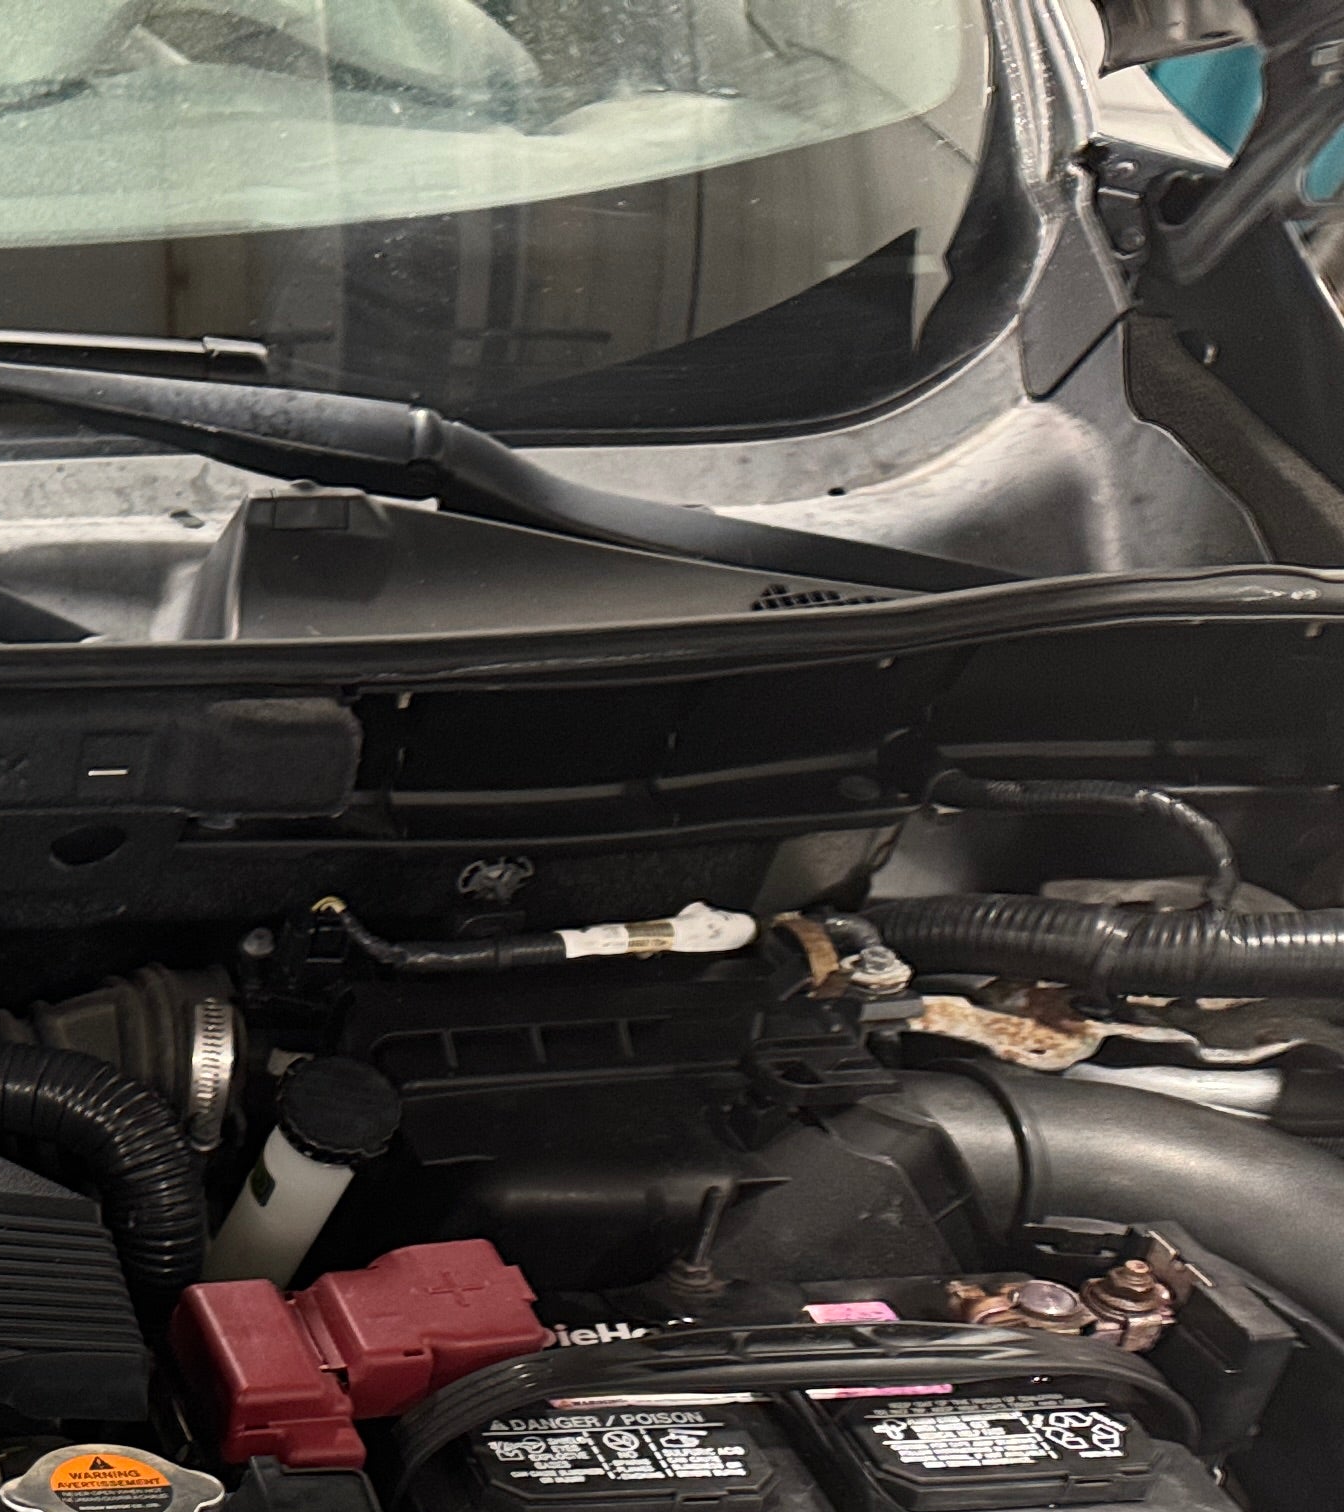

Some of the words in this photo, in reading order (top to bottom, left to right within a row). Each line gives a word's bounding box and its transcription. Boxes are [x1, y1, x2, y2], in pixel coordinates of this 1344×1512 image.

[509, 1416, 601, 1430] DANGER
[620, 1411, 704, 1425] POISON
[69, 1470, 141, 1480] WARNING
[57, 1478, 160, 1488] AVERTISSEMENT
